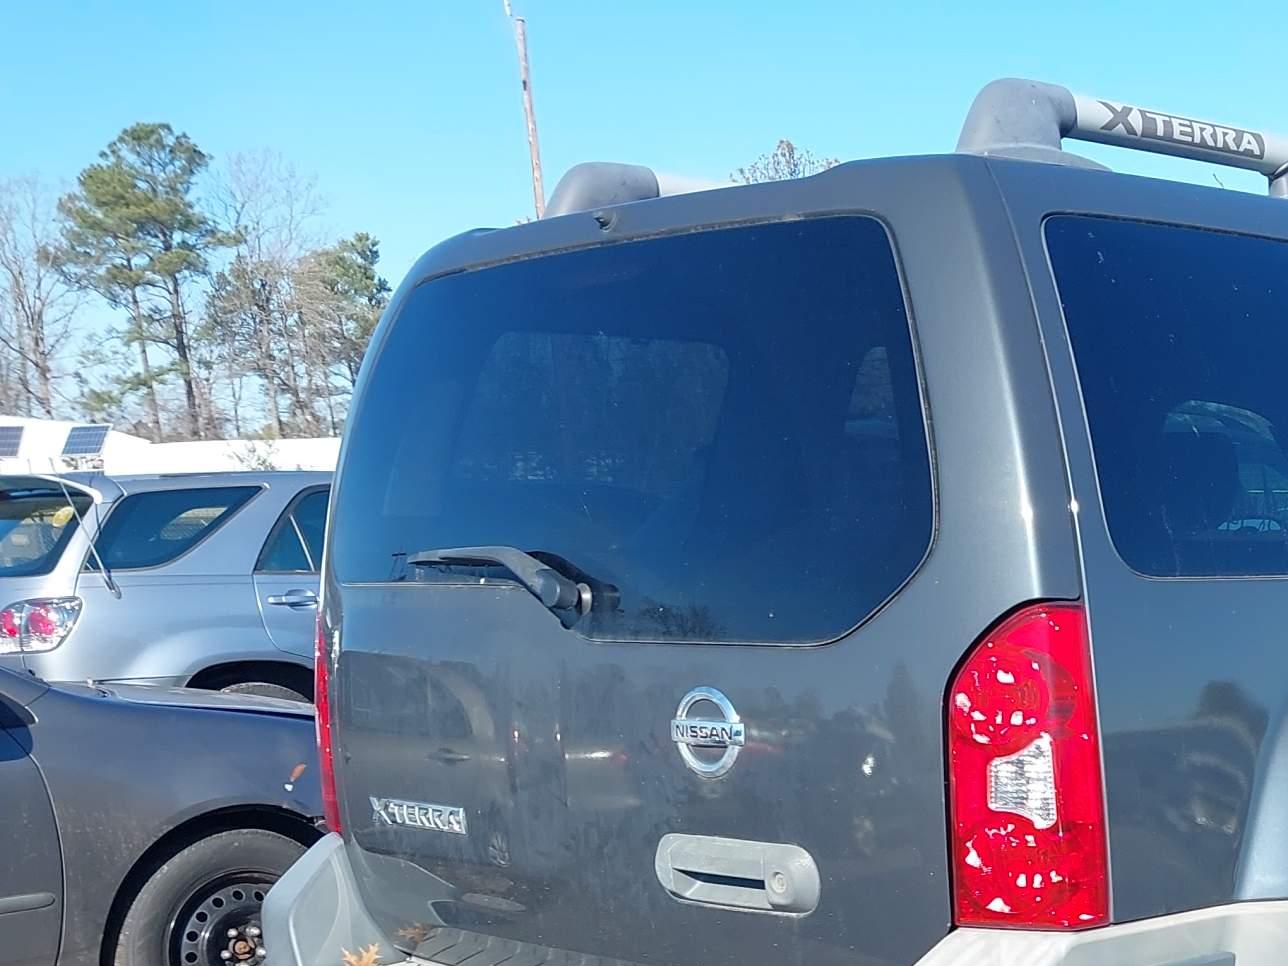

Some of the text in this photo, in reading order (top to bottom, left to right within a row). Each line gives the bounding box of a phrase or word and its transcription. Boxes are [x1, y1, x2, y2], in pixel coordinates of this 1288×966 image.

[1097, 100, 1265, 160] XTERRA
[675, 724, 734, 741] NISSAN
[369, 796, 466, 835] XTERRA
